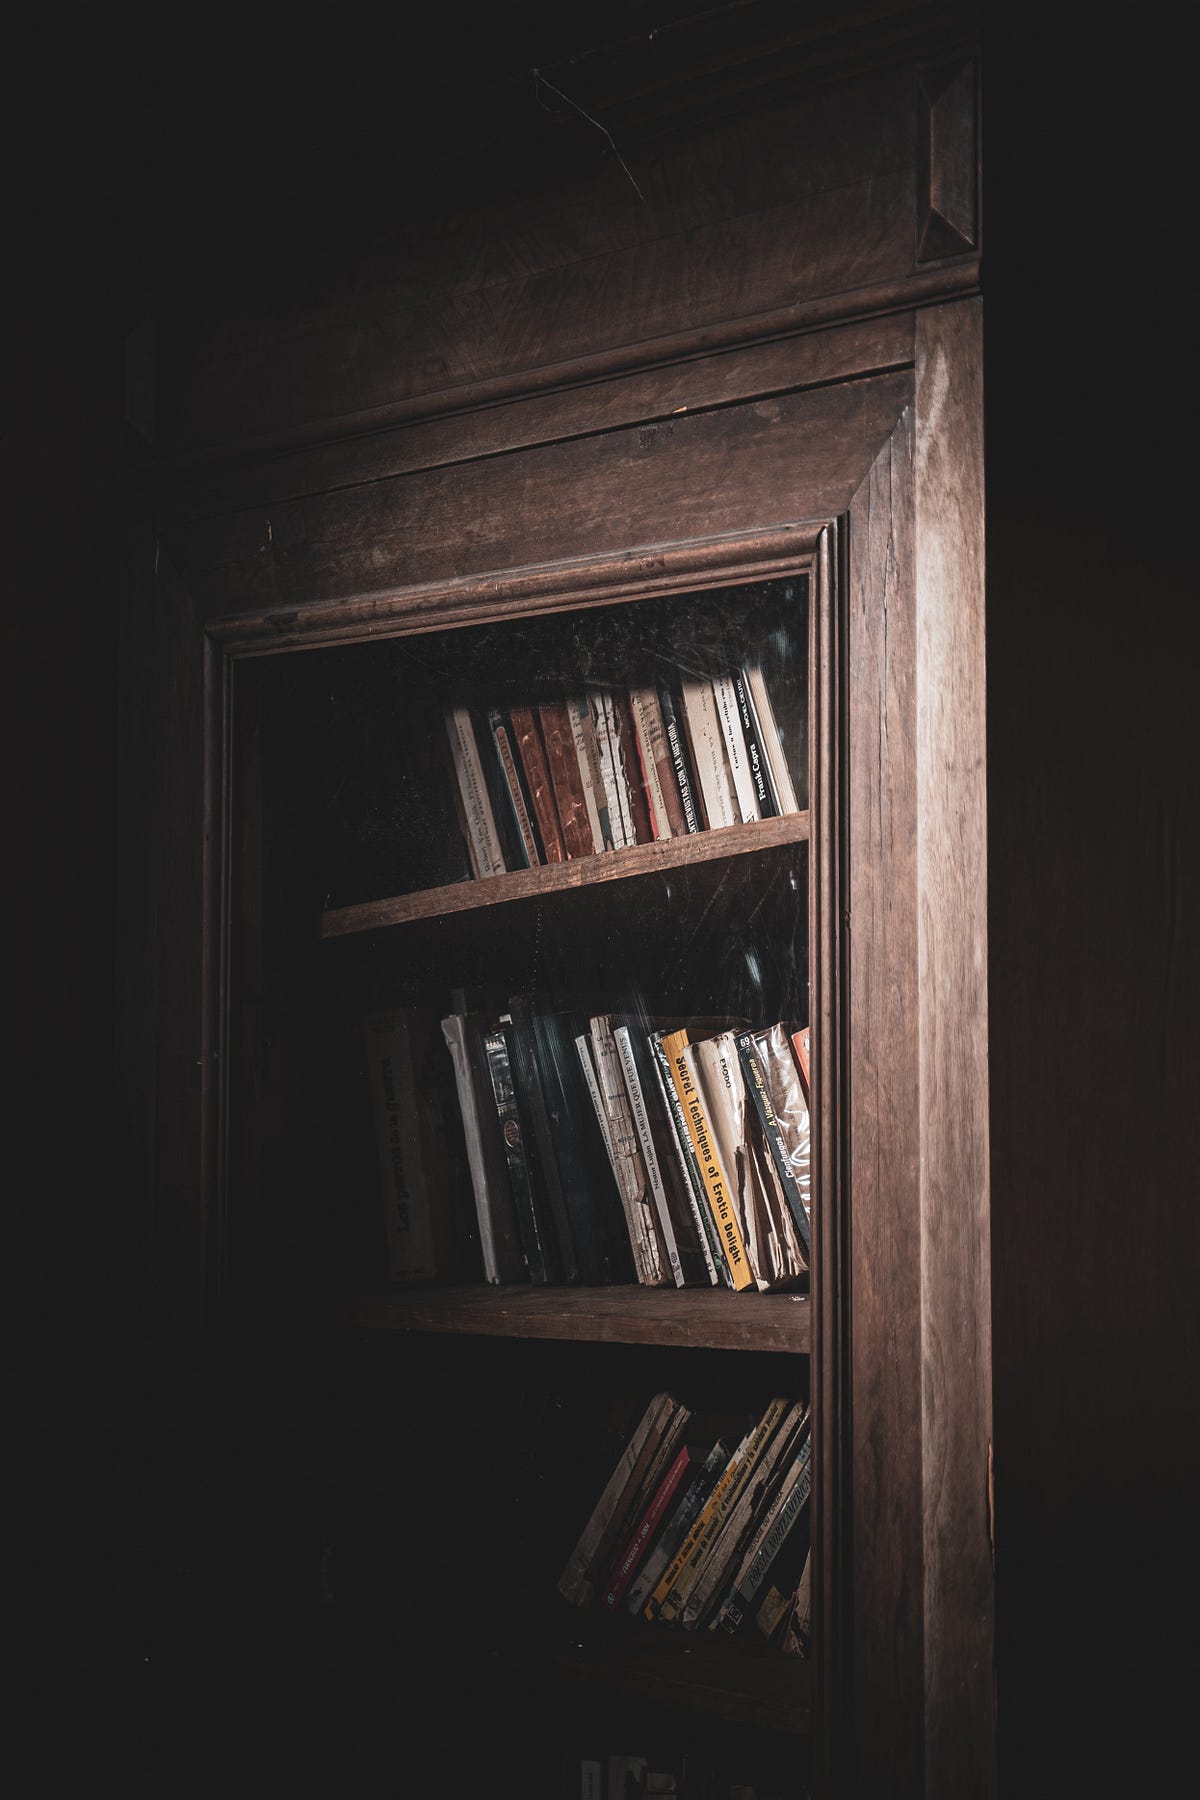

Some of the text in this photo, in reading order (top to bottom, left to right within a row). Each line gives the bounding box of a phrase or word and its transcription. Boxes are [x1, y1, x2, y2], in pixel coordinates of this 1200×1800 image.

[665, 722, 699, 834] ENTREVISTAS CON LA HISTORIA
[746, 742, 768, 800] Frank Capra
[674, 1055, 695, 1095] Secret
[719, 1058, 732, 1089] EXODO
[618, 1036, 660, 1189] Néstor Luján LA MUJER QUE FUE VENUS
[684, 1097, 716, 1163] Techniques
[707, 1165, 719, 1180] of
[773, 1135, 795, 1179] Cienfuegos
[710, 1182, 731, 1220] Erotic
[721, 1222, 744, 1265] Delight
[761, 1515, 771, 1527] DU
